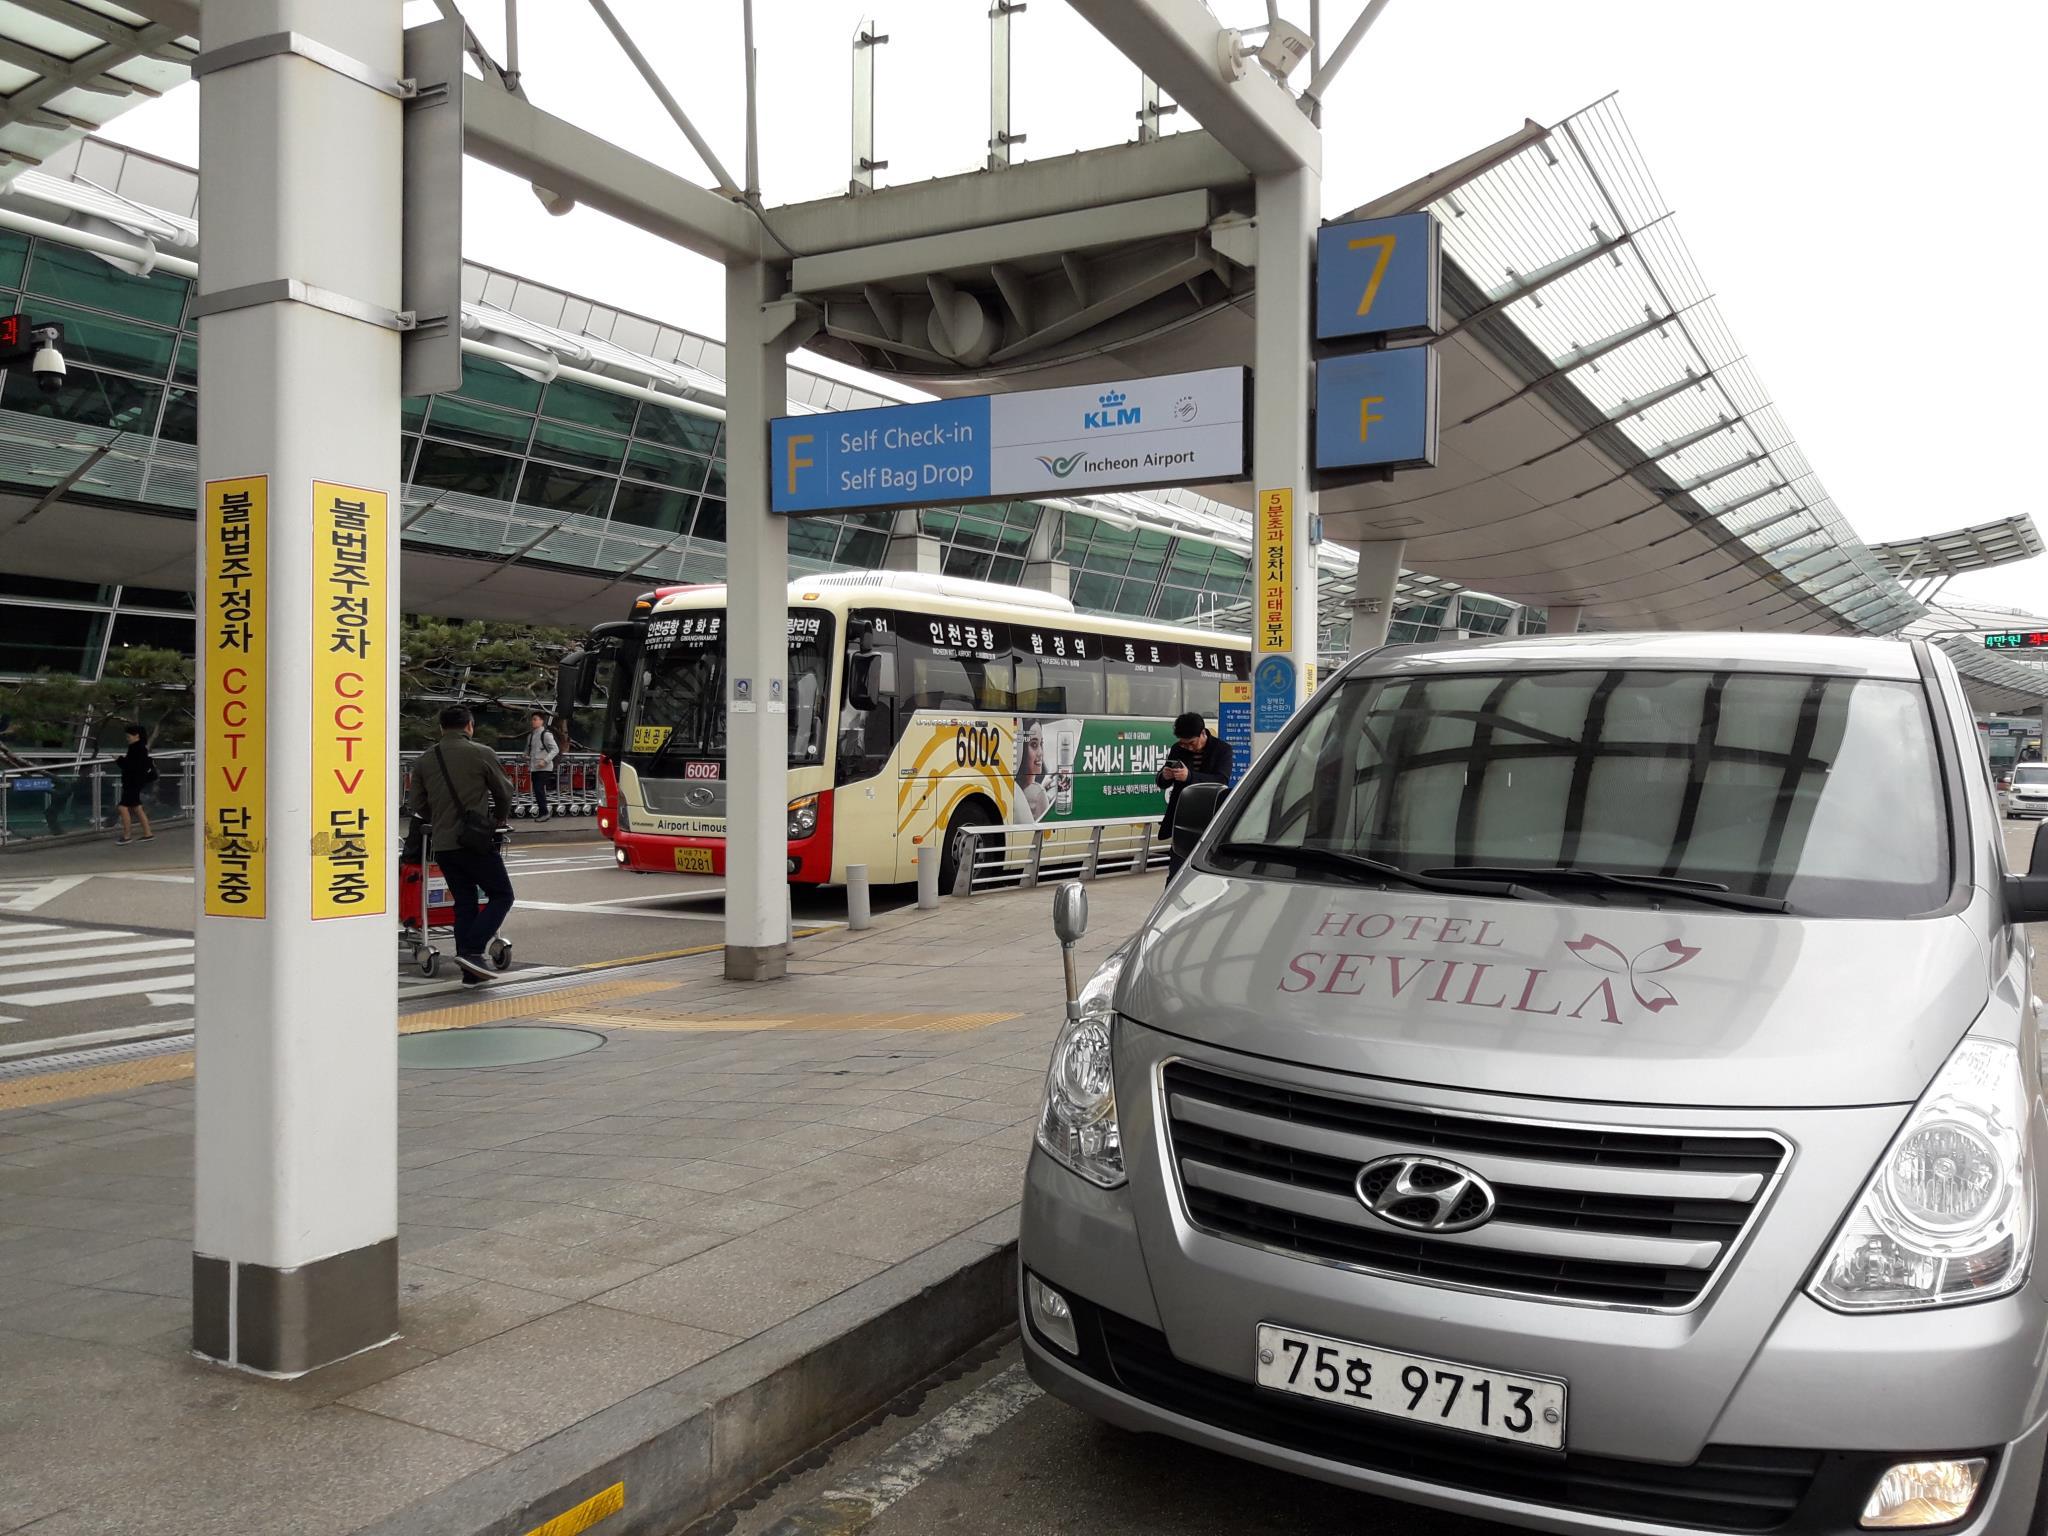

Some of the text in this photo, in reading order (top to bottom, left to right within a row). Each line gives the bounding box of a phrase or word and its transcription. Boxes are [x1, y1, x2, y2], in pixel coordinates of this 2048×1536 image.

[1348, 234, 1397, 316] 7
[1084, 407, 1141, 430] KLM
[1360, 396, 1385, 443] F
[841, 421, 972, 453] Self Check-in
[788, 434, 814, 495] F
[841, 464, 973, 491] Self Bag Drop
[1084, 451, 1195, 473] Incheon Airport
[1266, 493, 1285, 542] 5분초과
[1266, 545, 1285, 583] 정차시
[647, 619, 680, 637] 인천공항
[875, 618, 888, 633] 81
[929, 622, 994, 650] 인천공항
[217, 491, 253, 904] 불법주정차 CCTV 단속중
[328, 497, 371, 904] 불법주정차 CCTV 단속중
[956, 726, 1000, 768] 6002
[1083, 744, 1171, 776] 차에서 냄새날
[687, 764, 718, 778] 6002
[657, 819, 689, 831] Airport
[1311, 912, 1505, 948] HOTEL
[1277, 952, 1623, 1025] SEVILLA
[1283, 1339, 1534, 1434] 75호 9713
